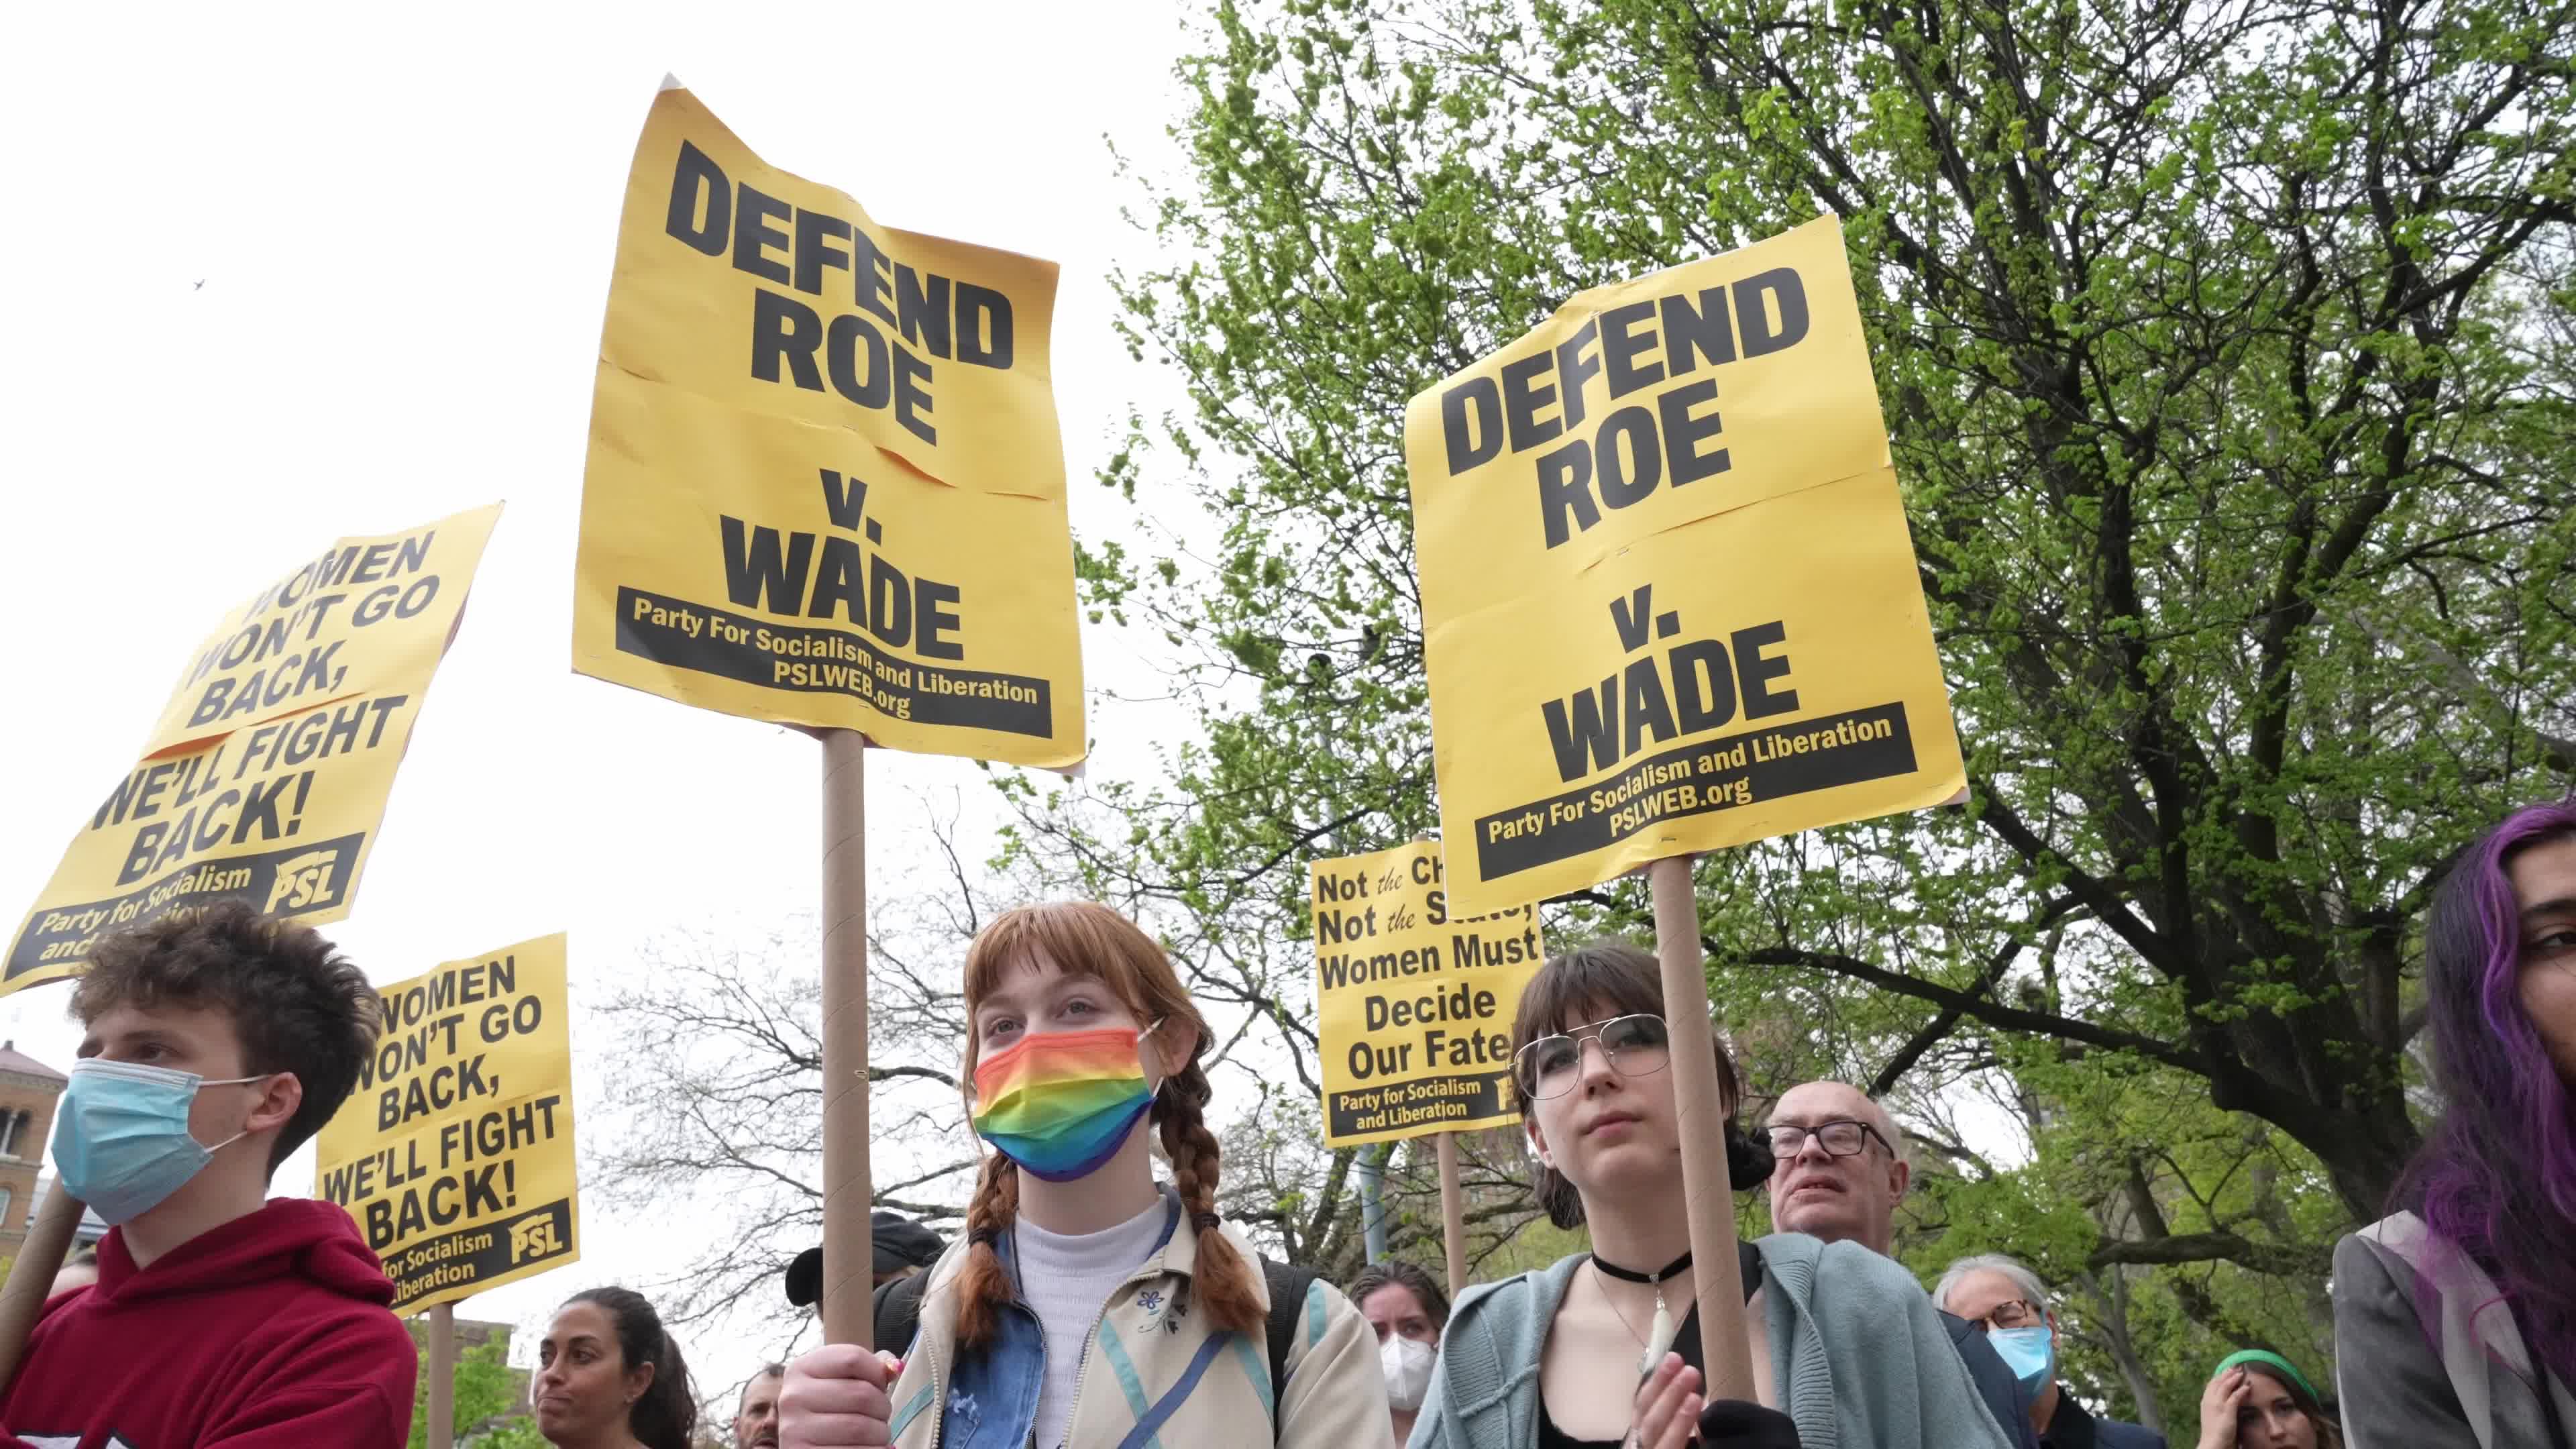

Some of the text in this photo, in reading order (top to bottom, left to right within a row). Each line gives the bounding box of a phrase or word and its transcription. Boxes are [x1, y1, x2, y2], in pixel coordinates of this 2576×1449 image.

[665, 139, 1014, 370] DEFEND
[751, 286, 936, 447] ROE
[1442, 267, 1809, 476] DEFEND
[1536, 378, 1731, 549] ROE
[819, 468, 882, 546] v.
[352, 575, 439, 627] GO
[720, 514, 963, 660] WADE
[1609, 583, 1680, 653] v.
[186, 639, 348, 729] BACK,
[633, 598, 1038, 704] Party For Socialism and Liberation
[774, 660, 911, 720] PSLWEB.org
[1542, 620, 1800, 783] WADE
[91, 696, 408, 830] WE'LL FIGHT
[1488, 716, 1892, 844] Party For Socialism and Liberation
[115, 770, 315, 887] BACK!
[1610, 775, 1753, 838] PSLWEB.org
[37, 912, 109, 935] Party
[109, 899, 144, 924] for
[144, 863, 252, 913] Socialism
[263, 850, 339, 915] PSL
[1318, 869, 1368, 903] Not
[1377, 867, 1402, 895] the
[1319, 904, 1377, 945] Not
[1387, 904, 1416, 934] the
[1320, 926, 1538, 990] Women Must
[480, 995, 541, 1043] GO
[1365, 982, 1495, 1032] Decide
[378, 1053, 500, 1132] BACK,
[1340, 1093, 1380, 1112] Party
[1383, 1087, 1405, 1106] for
[1408, 1080, 1481, 1100] Socialism
[1348, 1041, 1412, 1080] Our
[323, 1095, 561, 1206] WE'LL FIGHT
[1356, 1101, 1467, 1130] and Liberation
[366, 1159, 517, 1252] BACK!
[407, 1232, 493, 1271] Socialism
[508, 1212, 563, 1264] PSL
[391, 1262, 475, 1303] iberation
